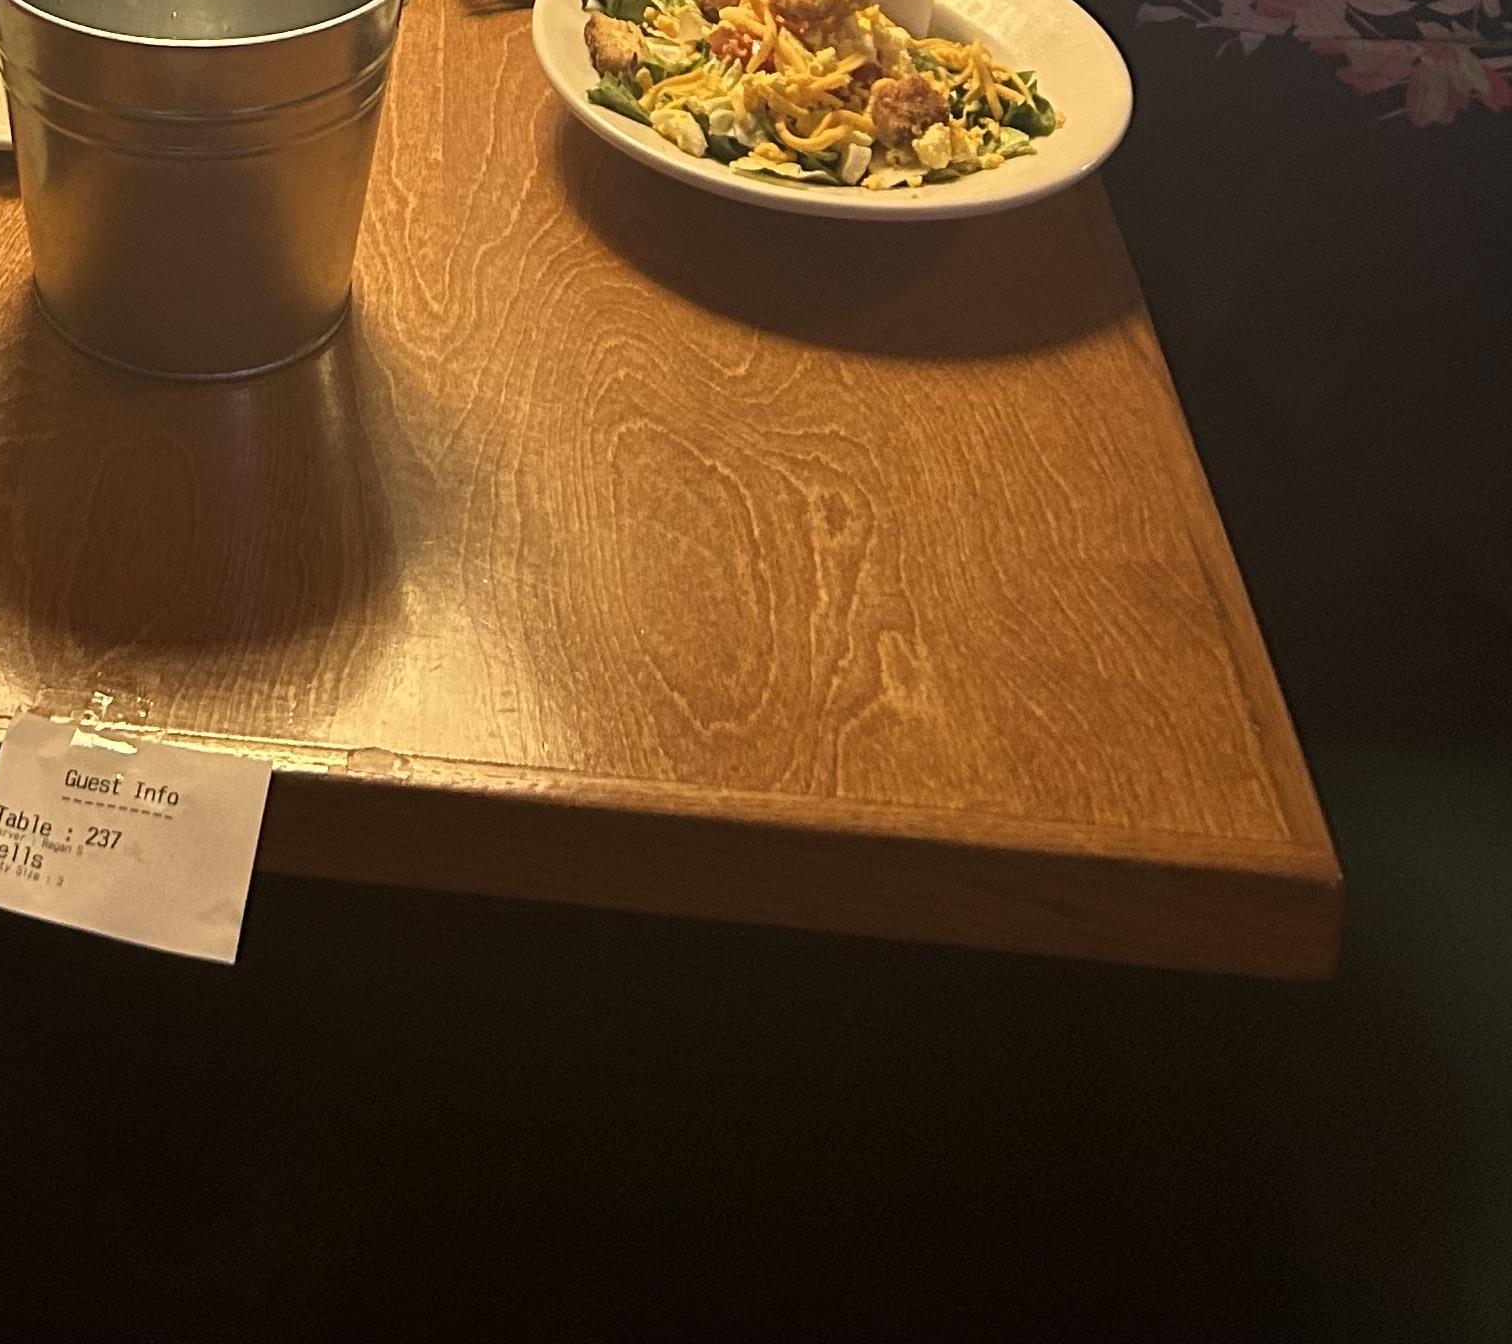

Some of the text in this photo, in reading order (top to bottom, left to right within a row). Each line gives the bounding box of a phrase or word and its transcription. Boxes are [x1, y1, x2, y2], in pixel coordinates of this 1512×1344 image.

[64, 768, 180, 807] Guest Info
[84, 825, 123, 849] 237
